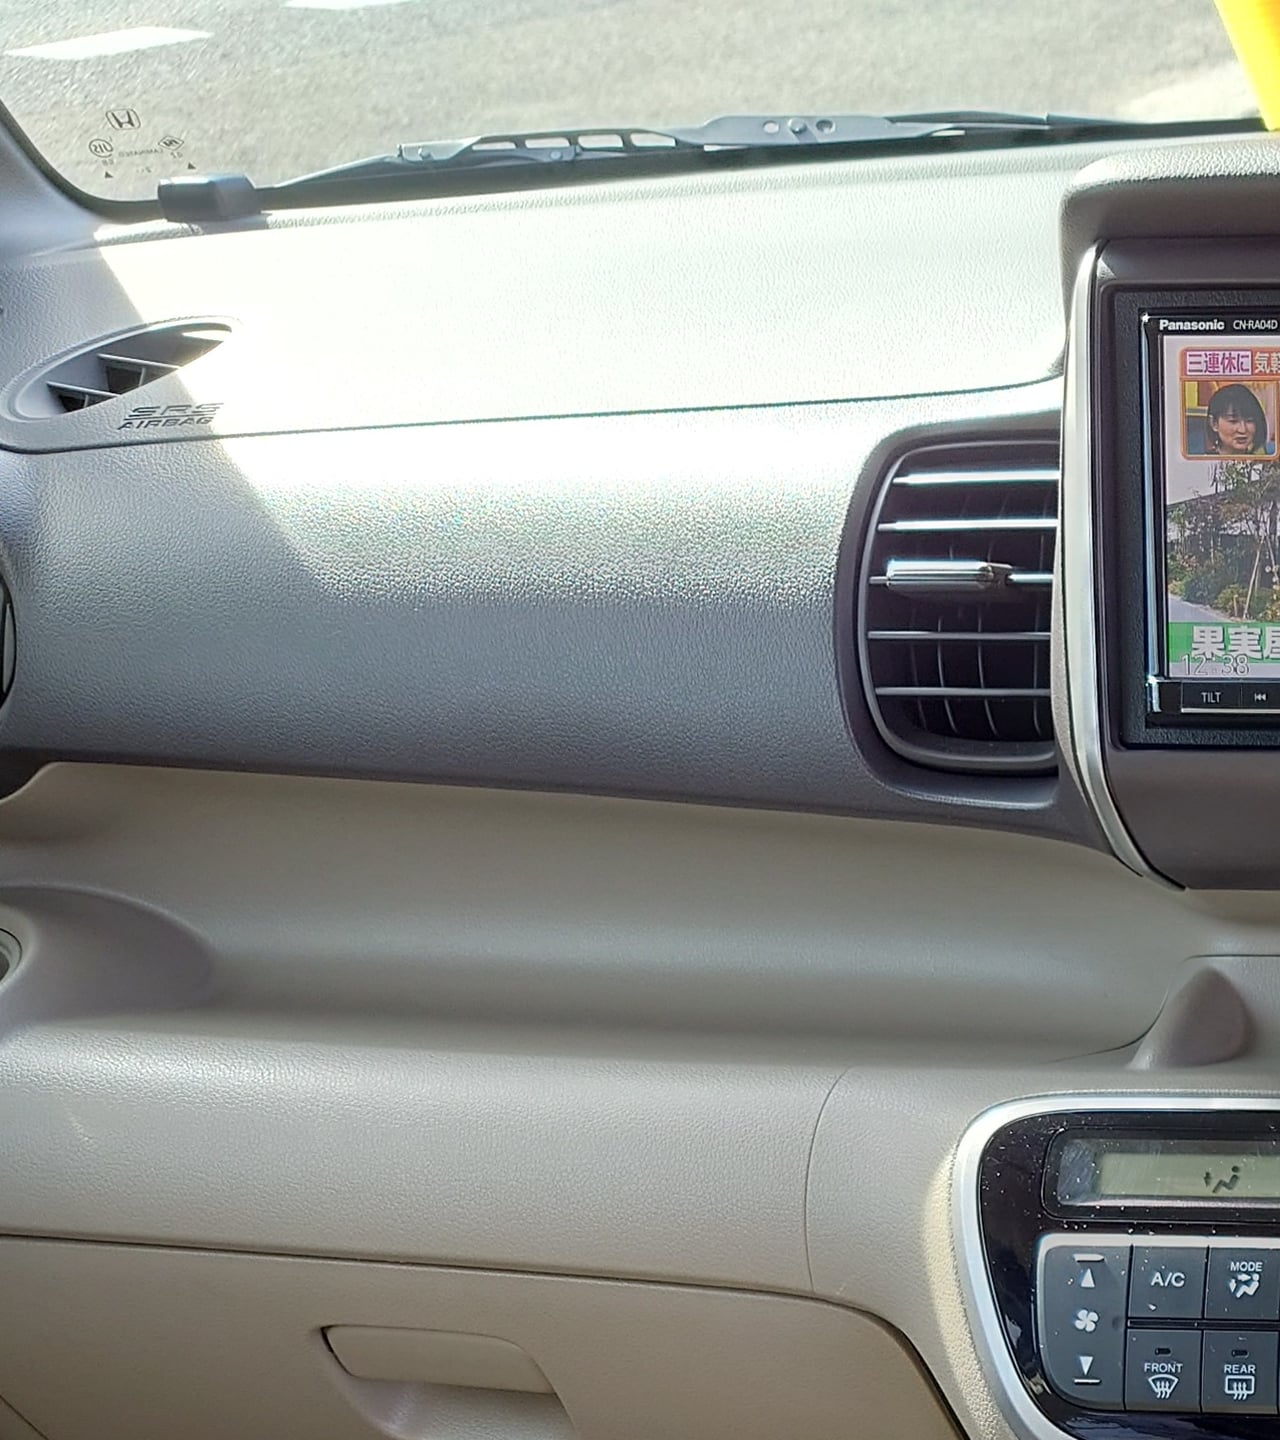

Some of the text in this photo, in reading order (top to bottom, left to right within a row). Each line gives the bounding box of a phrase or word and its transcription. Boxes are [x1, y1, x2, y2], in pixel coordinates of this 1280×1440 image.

[1159, 318, 1278, 331] Panasonic CN-RA04D
[1187, 351, 1250, 375] 三連休に
[127, 402, 224, 417] SRS
[117, 416, 214, 430] AIRBAG
[1180, 654, 1250, 677] 12:38
[1200, 691, 1222, 703] TILT
[1230, 1261, 1263, 1273] MODE
[1150, 1270, 1185, 1289] A/C
[1144, 1362, 1184, 1375] FRONT
[1223, 1363, 1256, 1375] REAR
